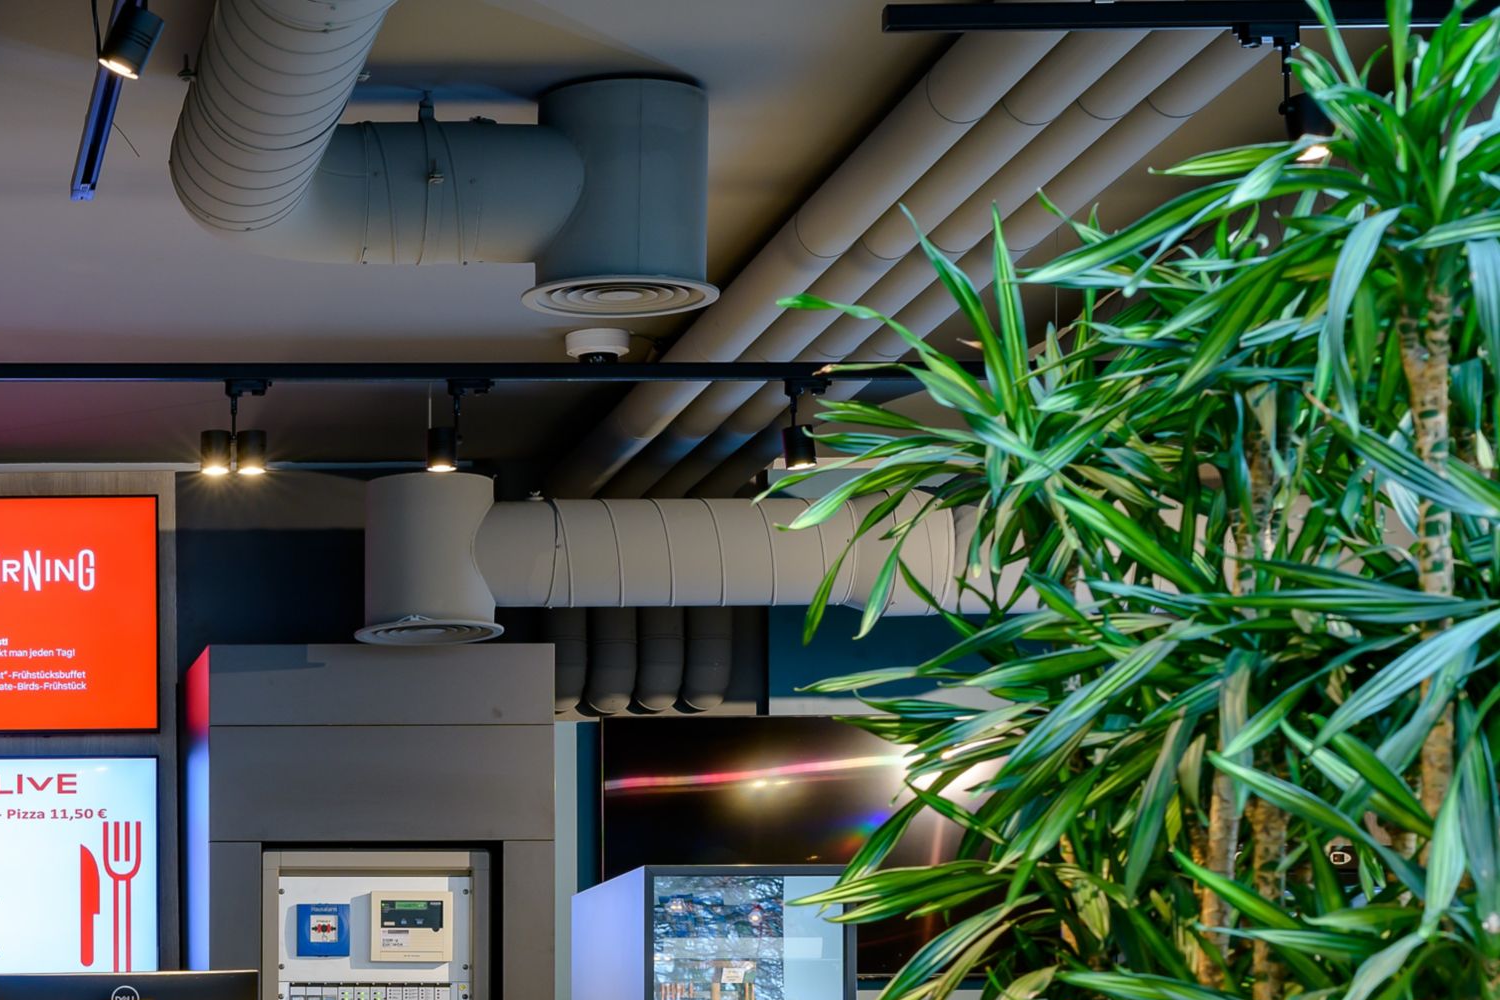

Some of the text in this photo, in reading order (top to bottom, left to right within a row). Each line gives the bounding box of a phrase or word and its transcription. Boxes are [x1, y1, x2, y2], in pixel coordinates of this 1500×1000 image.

[9, 650, 28, 658] man
[29, 648, 54, 659] jeden
[7, 808, 46, 820] Pizza
[50, 808, 94, 821] 11,50
[97, 808, 107, 819] €
